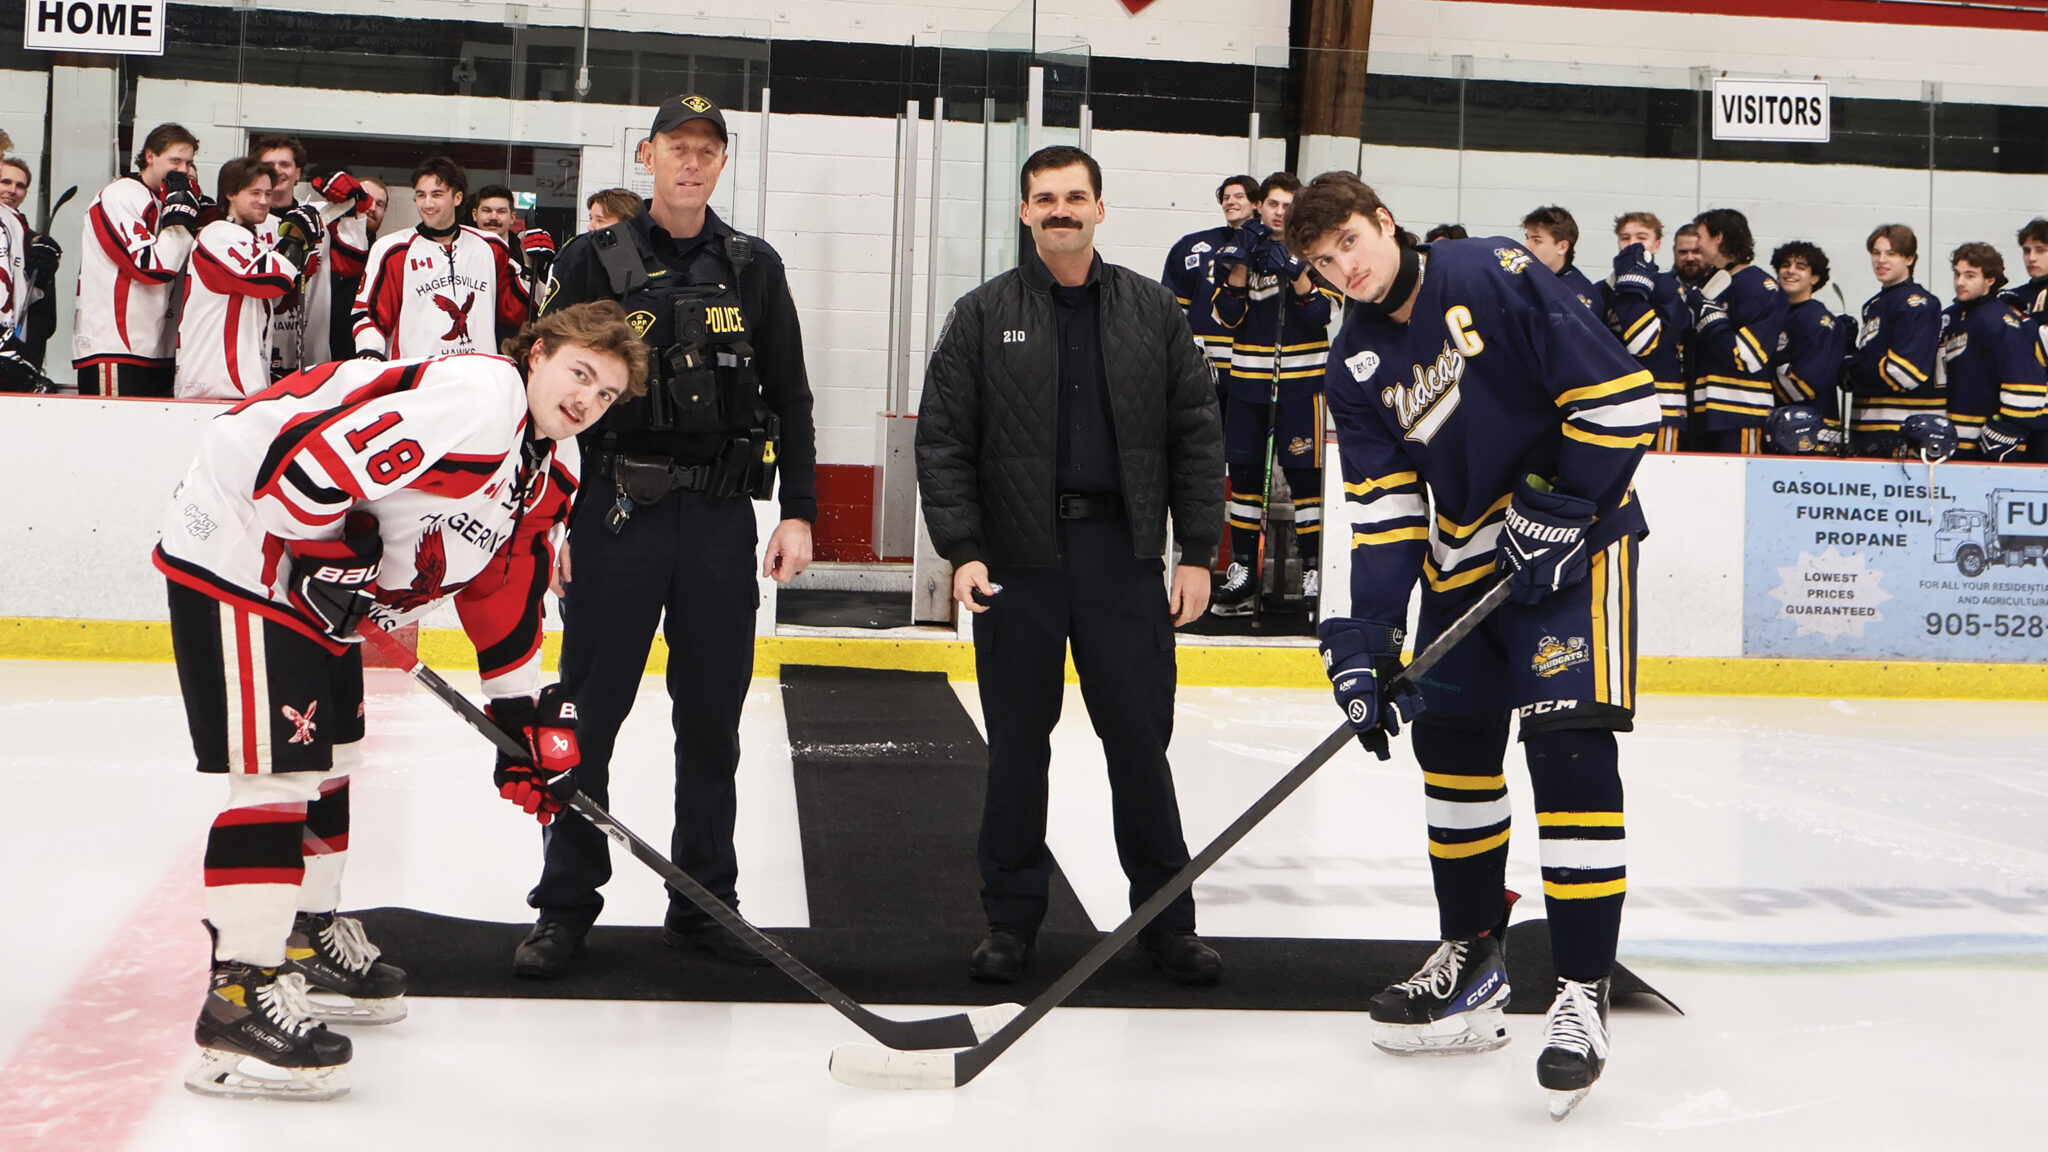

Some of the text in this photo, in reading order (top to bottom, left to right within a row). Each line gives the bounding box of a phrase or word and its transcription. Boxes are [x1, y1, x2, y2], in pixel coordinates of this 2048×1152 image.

[38, 1, 152, 36] HOME
[1721, 94, 1822, 126] VISITORS
[415, 275, 488, 297] HAGERSVILLE
[705, 307, 745, 333] POLICE
[1445, 305, 1484, 357] C
[1003, 330, 1026, 343] 210
[344, 411, 425, 485] 18
[1772, 480, 1957, 502] GASOLINE, DIESEL,
[1796, 506, 1933, 526] FURNACE OIL,
[2008, 502, 2048, 526] FU
[1815, 531, 1907, 547] PROPANE
[313, 559, 382, 585] BAU
[1804, 572, 1858, 583] LOWEST
[1807, 589, 1855, 600] PRICES
[1920, 580, 1939, 590] FOR
[1941, 581, 1960, 590] ALL
[1962, 581, 1990, 592] YOUR
[1785, 604, 1876, 617] GUARANTEED
[1957, 596, 1980, 605] AND
[1539, 650, 1583, 672] MUDCATS
[1520, 699, 1578, 718] CCM
[1466, 971, 1498, 1006] CCM
